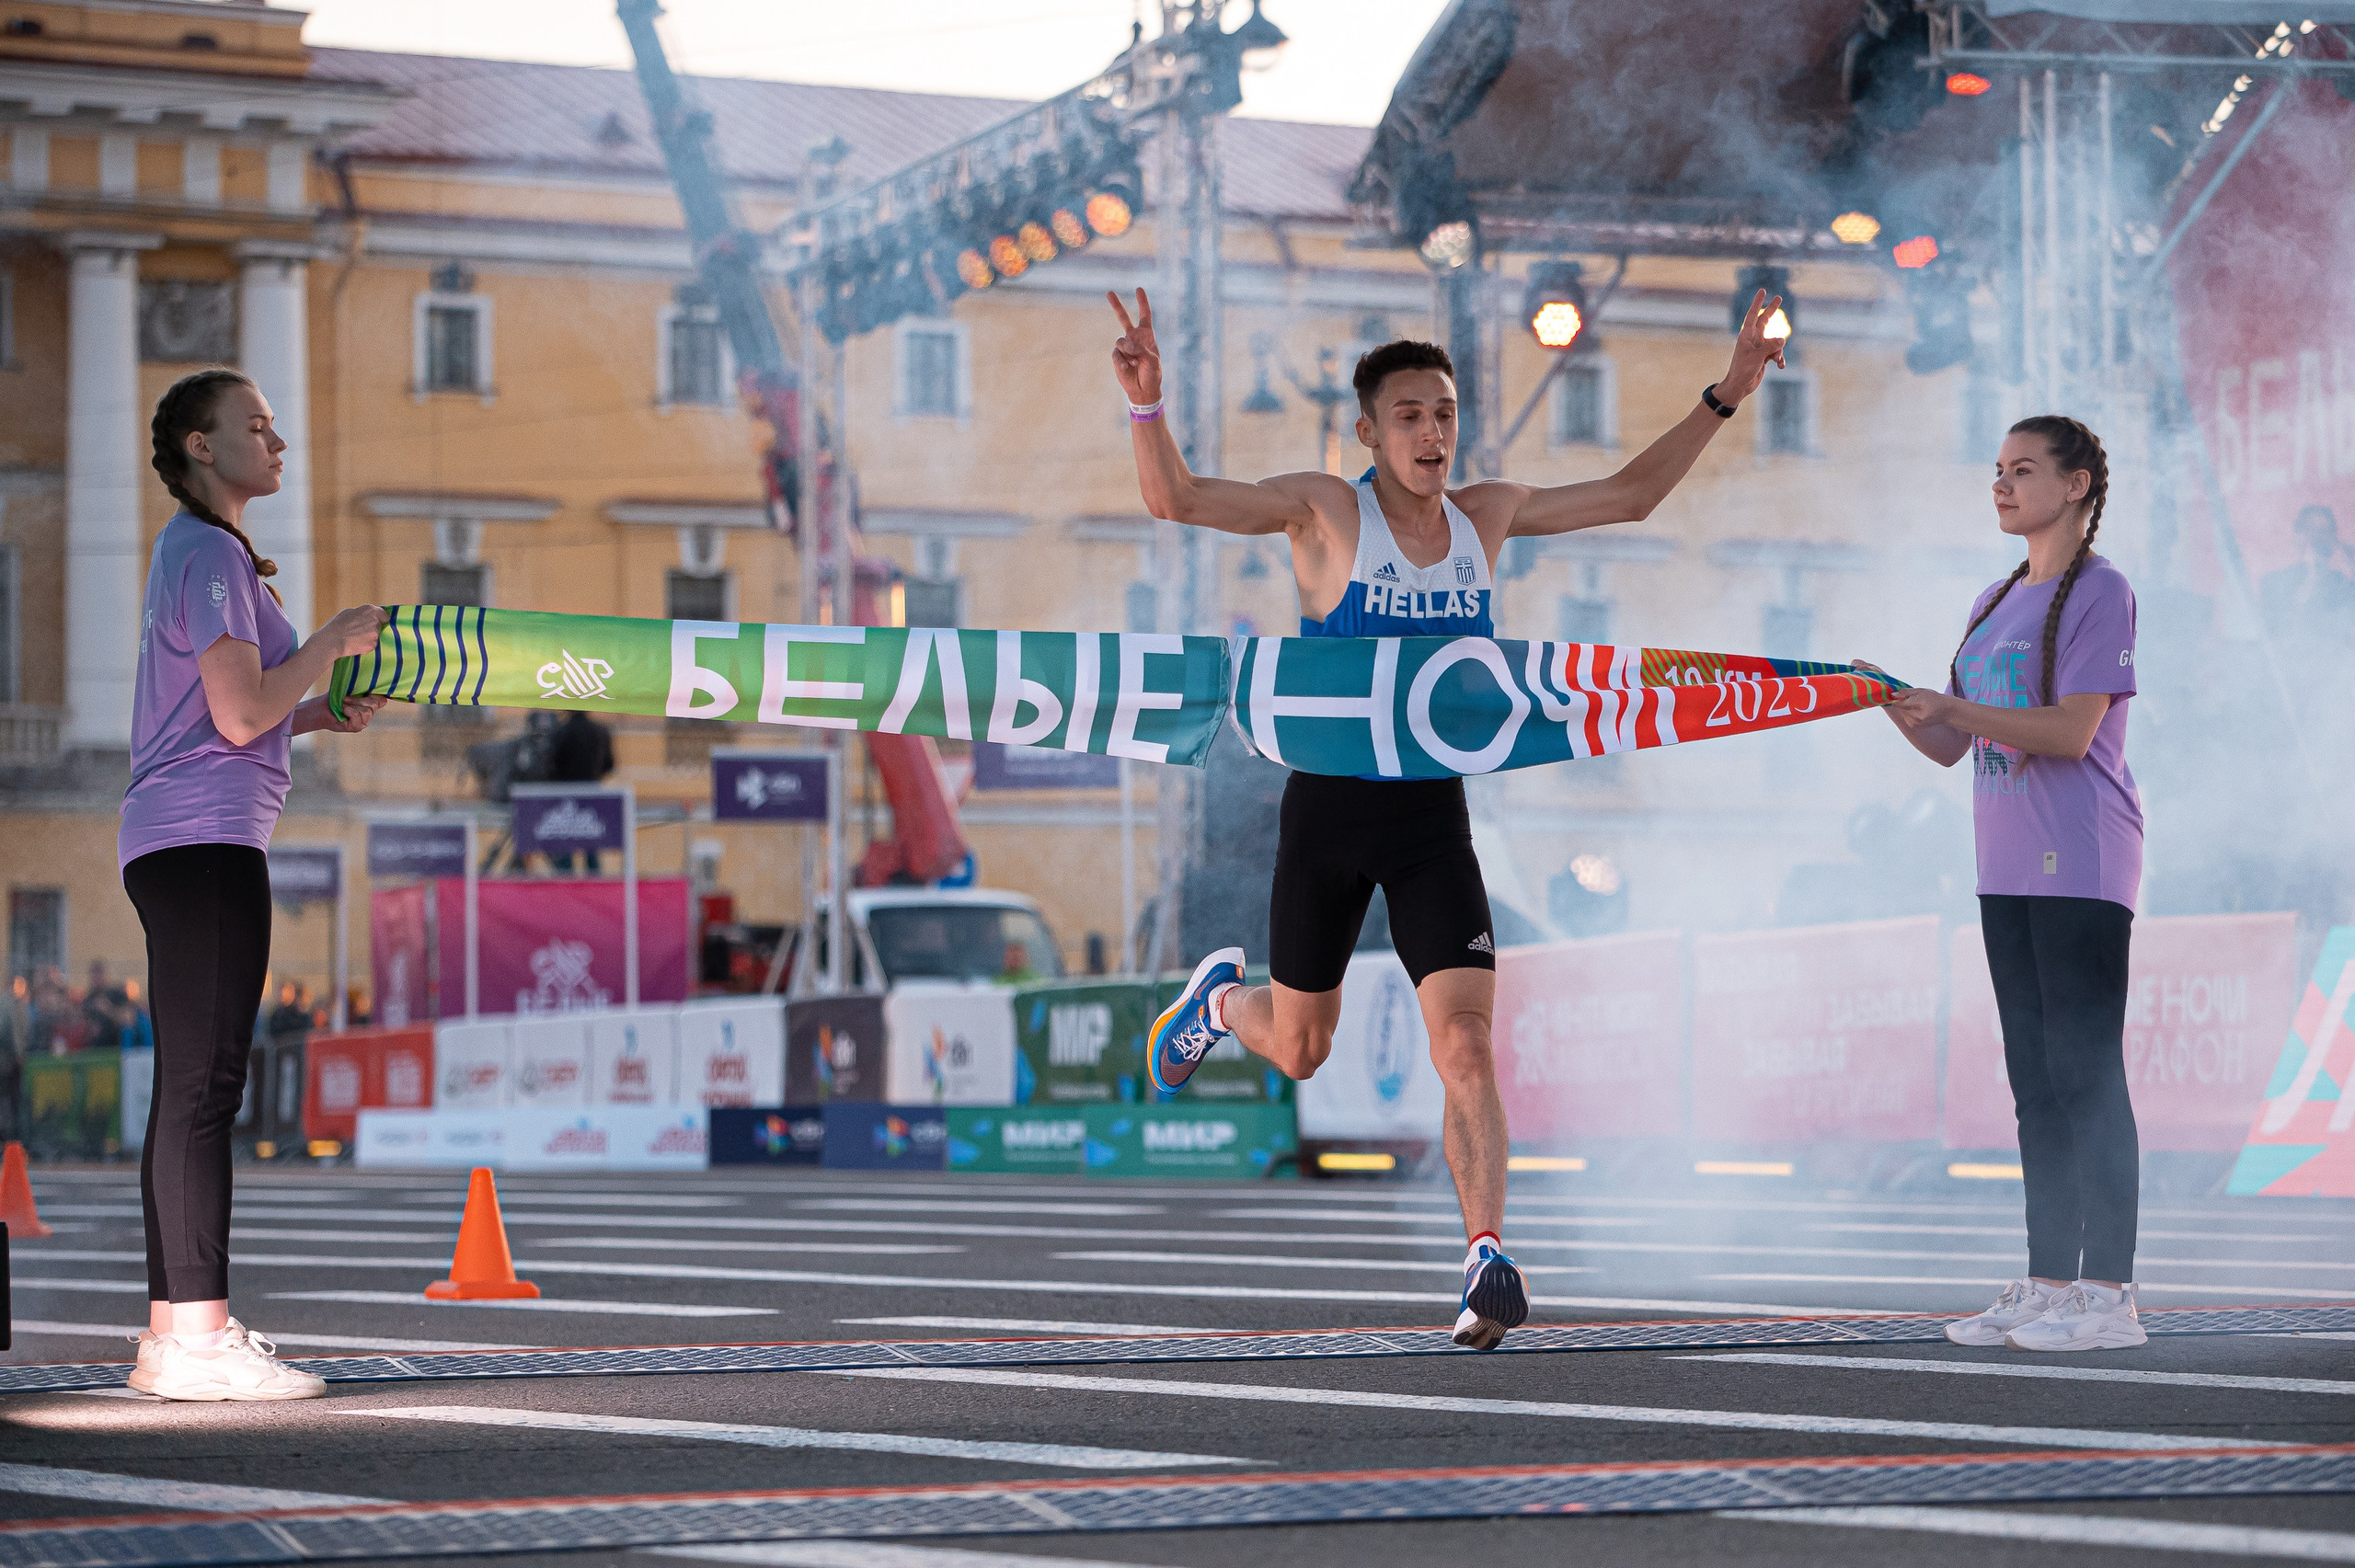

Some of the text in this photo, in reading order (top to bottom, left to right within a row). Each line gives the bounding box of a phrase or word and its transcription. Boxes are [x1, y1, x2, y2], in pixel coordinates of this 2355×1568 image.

[1373, 571, 1400, 583] adidas
[1364, 584, 1480, 619] HELLAS
[666, 620, 1680, 778] БЕЛЫЕ НОЧИ
[1705, 676, 1818, 727] 2023
[1467, 943, 1495, 956] adidas
